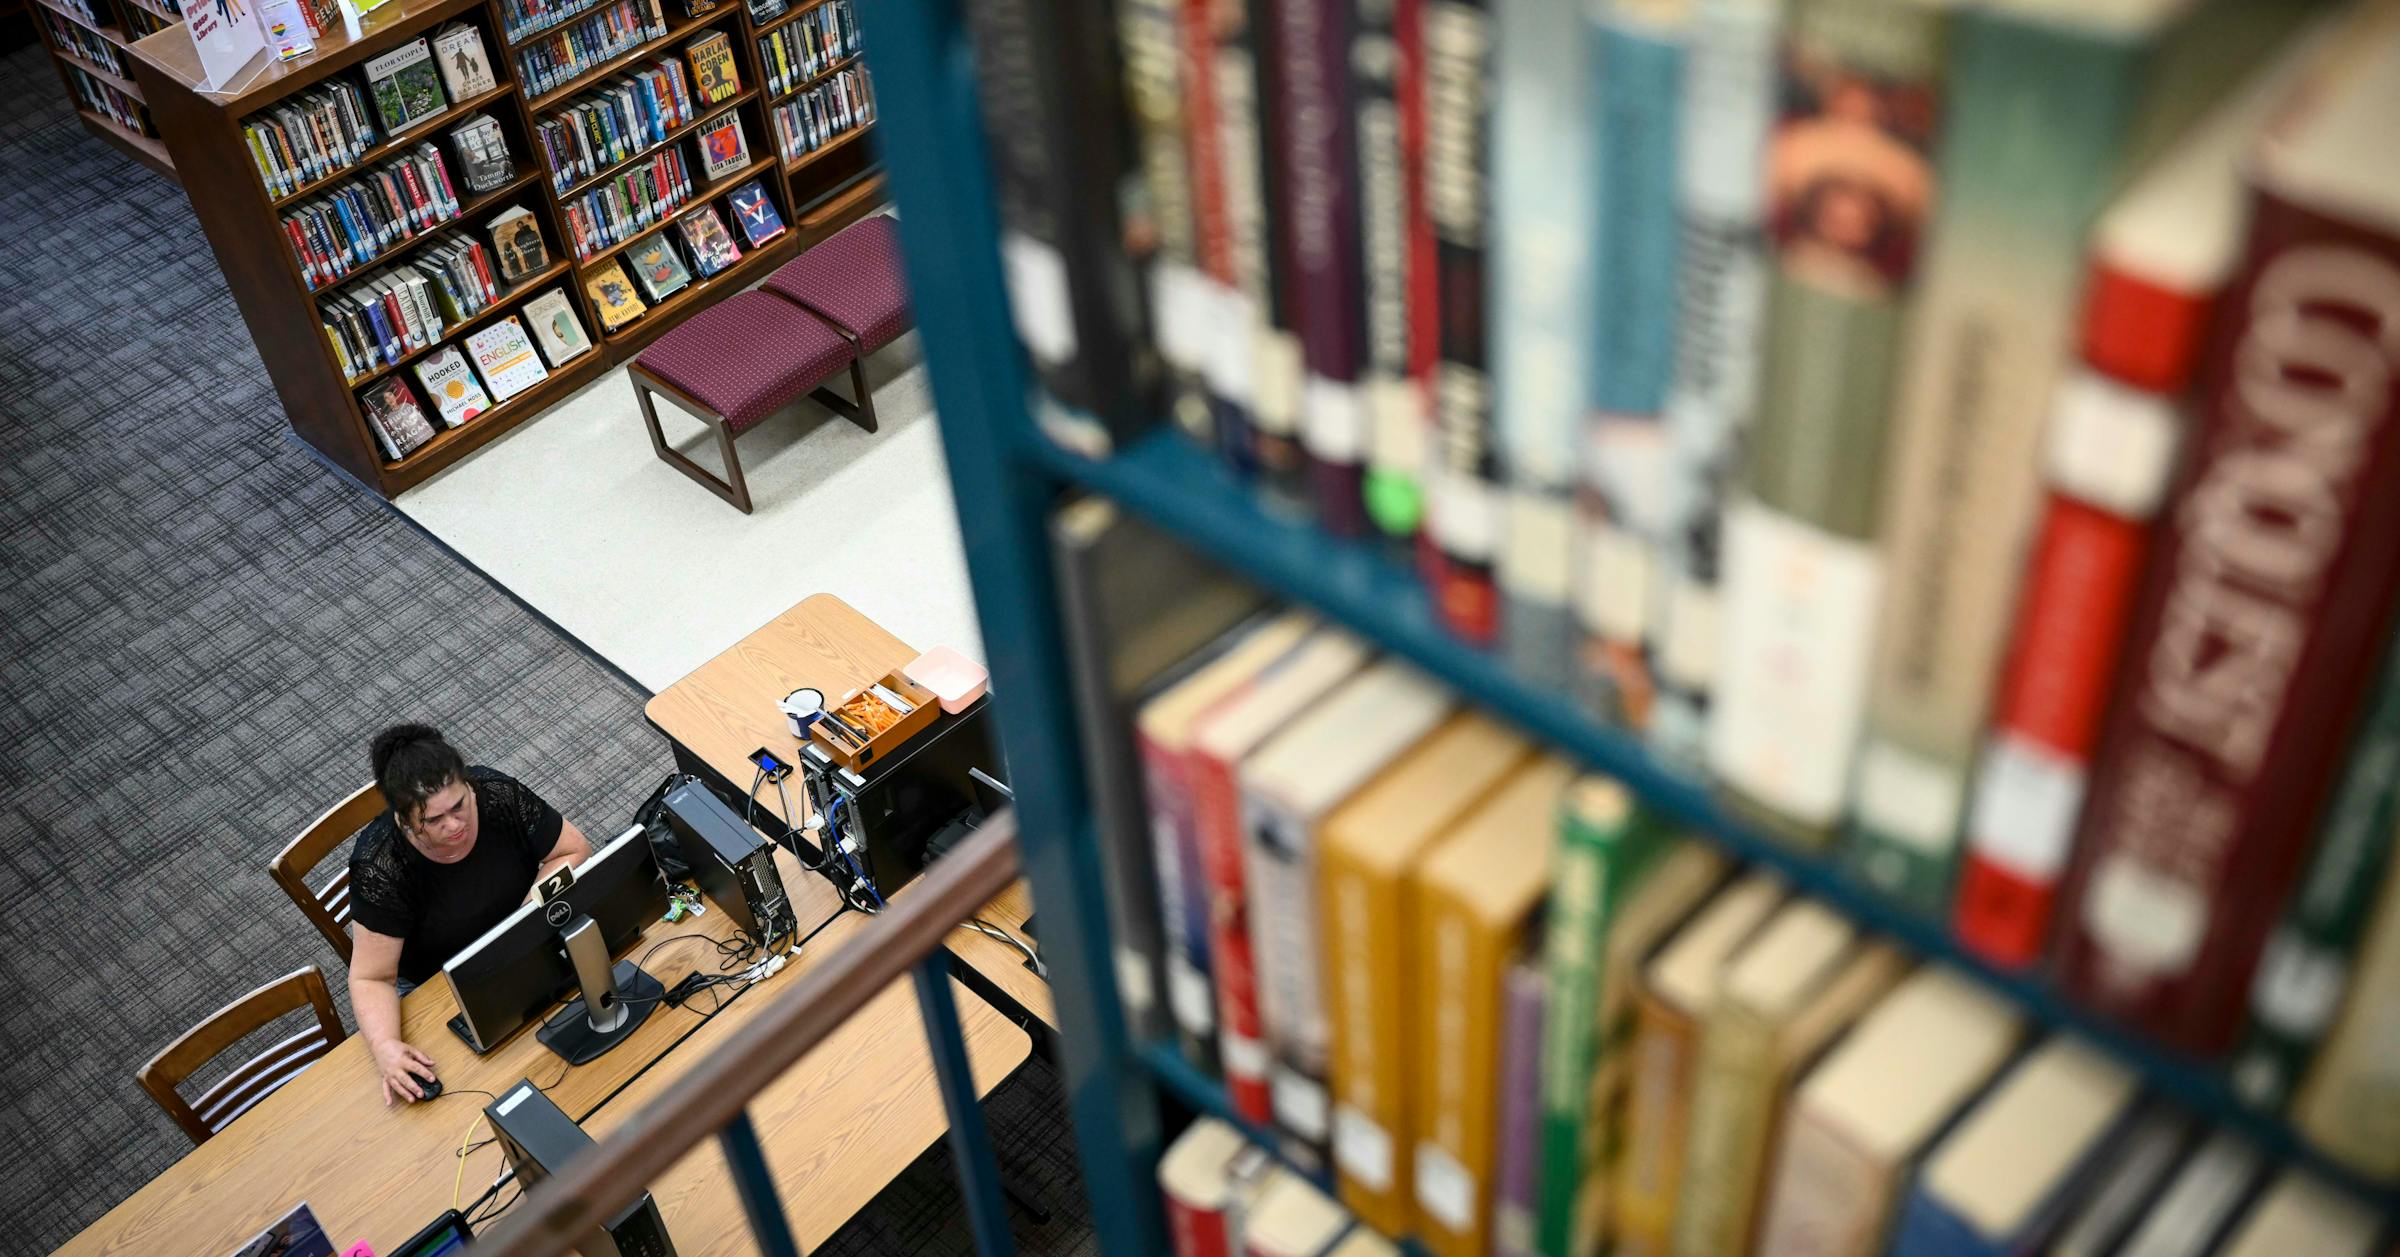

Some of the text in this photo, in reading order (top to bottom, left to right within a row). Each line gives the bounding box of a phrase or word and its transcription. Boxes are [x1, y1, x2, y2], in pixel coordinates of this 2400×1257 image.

[442, 36, 478, 54] DREAM
[694, 38, 730, 64] HARLAN
[375, 46, 424, 72] FLORATOPIA
[700, 53, 730, 73] COBEN
[458, 79, 492, 96] GARDNER
[709, 81, 736, 103] WIN
[588, 111, 602, 144] TOM CLANCY
[700, 113, 737, 136] ANIMAL
[478, 169, 504, 182] Tammy
[711, 162, 724, 172] LISA
[474, 172, 514, 191] Duckworth
[398, 290, 418, 326] CALHOUN
[480, 336, 526, 366] ENGLISH
[428, 360, 460, 383] HOOKED
[447, 393, 482, 415] MICHAEL MOSS
[395, 421, 429, 446] REAGAN
[549, 876, 564, 894] 2
[550, 906, 568, 922] DELL
